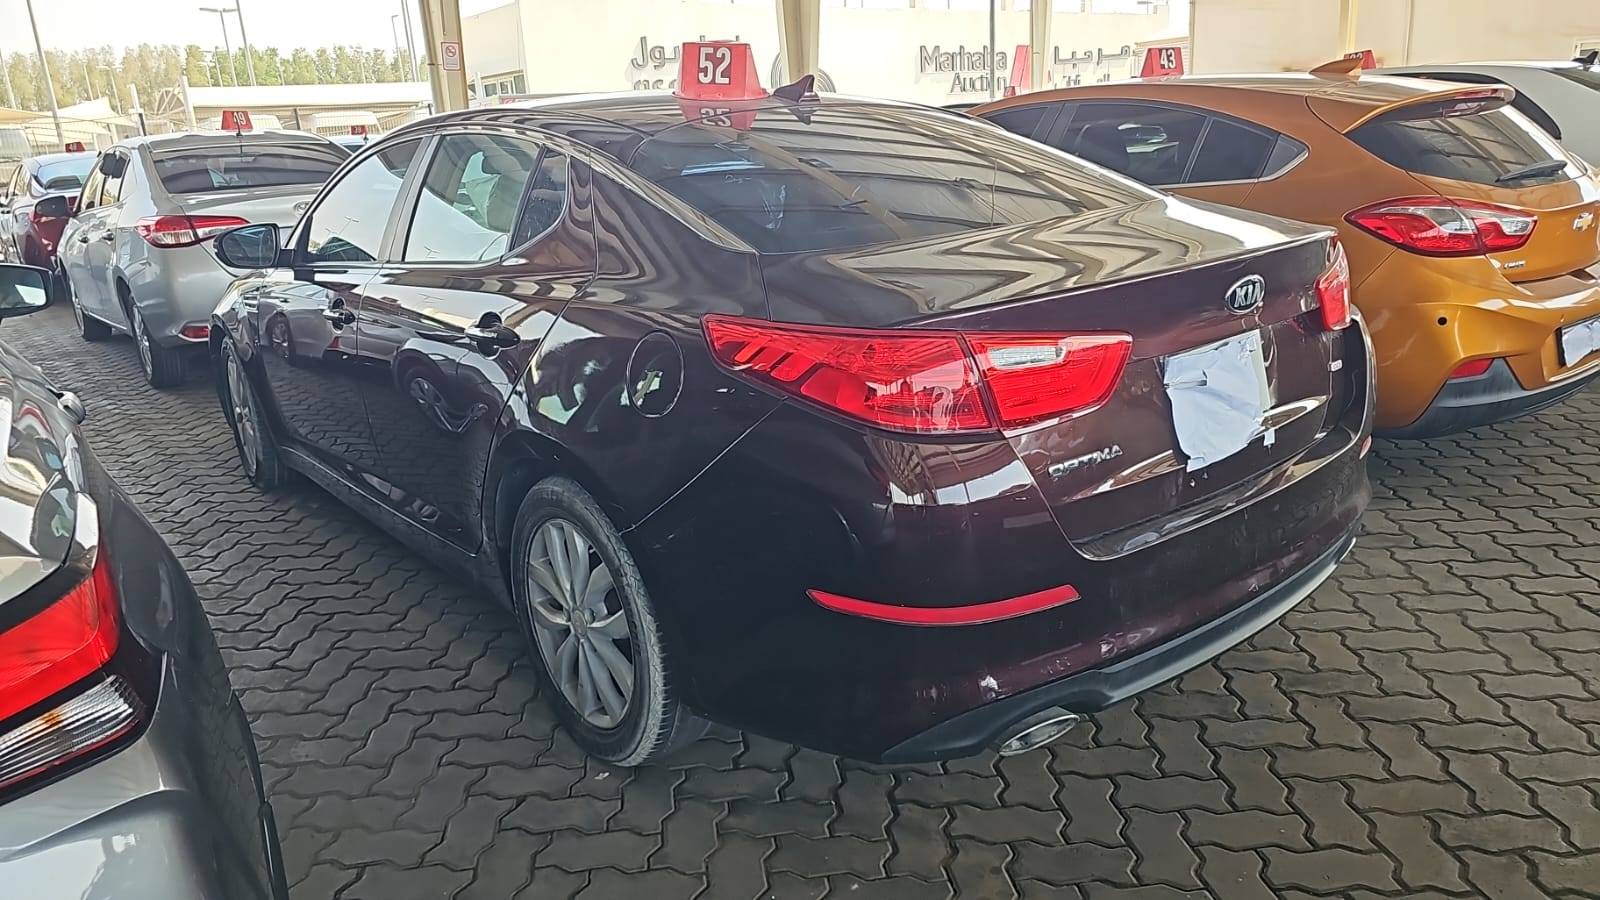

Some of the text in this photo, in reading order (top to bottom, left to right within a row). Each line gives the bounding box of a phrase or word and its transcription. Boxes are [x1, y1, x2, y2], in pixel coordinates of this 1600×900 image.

[698, 46, 731, 84] 52
[1160, 49, 1176, 69] 43
[950, 72, 1008, 93] Auctin
[1233, 281, 1262, 308] KIA
[1048, 444, 1123, 477] OPTIMA
